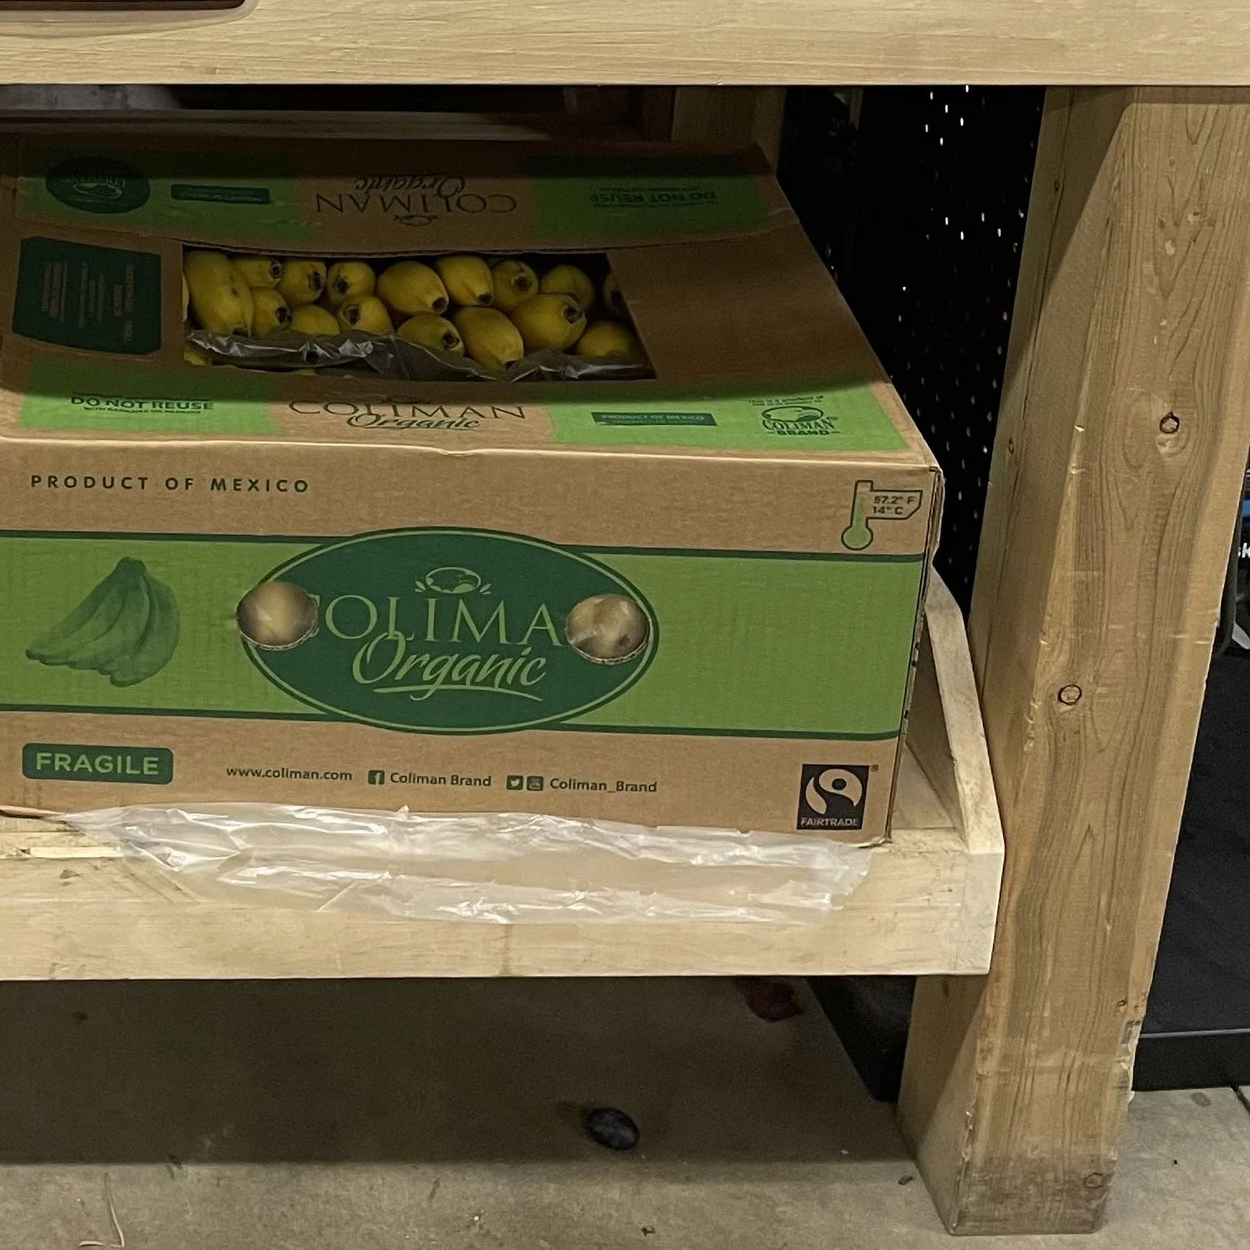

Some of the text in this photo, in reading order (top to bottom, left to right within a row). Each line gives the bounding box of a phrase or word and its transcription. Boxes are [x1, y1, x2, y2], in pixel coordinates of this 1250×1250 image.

[316, 193, 517, 215] COLIMAN
[71, 396, 100, 406] DO
[106, 399, 147, 409] NOT
[152, 401, 214, 410] REUSE
[289, 400, 525, 421] COLIMAN
[347, 413, 480, 430] Organic
[762, 418, 835, 431] COLIMAN
[30, 474, 309, 493] PRODUCT OF MEXICO
[895, 506, 904, 515] C
[311, 594, 567, 648] OLIMA
[352, 631, 547, 701] Organic
[35, 752, 159, 775] FRAGILE
[226, 766, 657, 793] www.coliman.com Coliman Brand Coliman_Brand
[800, 817, 860, 827] FAIRTRADE
